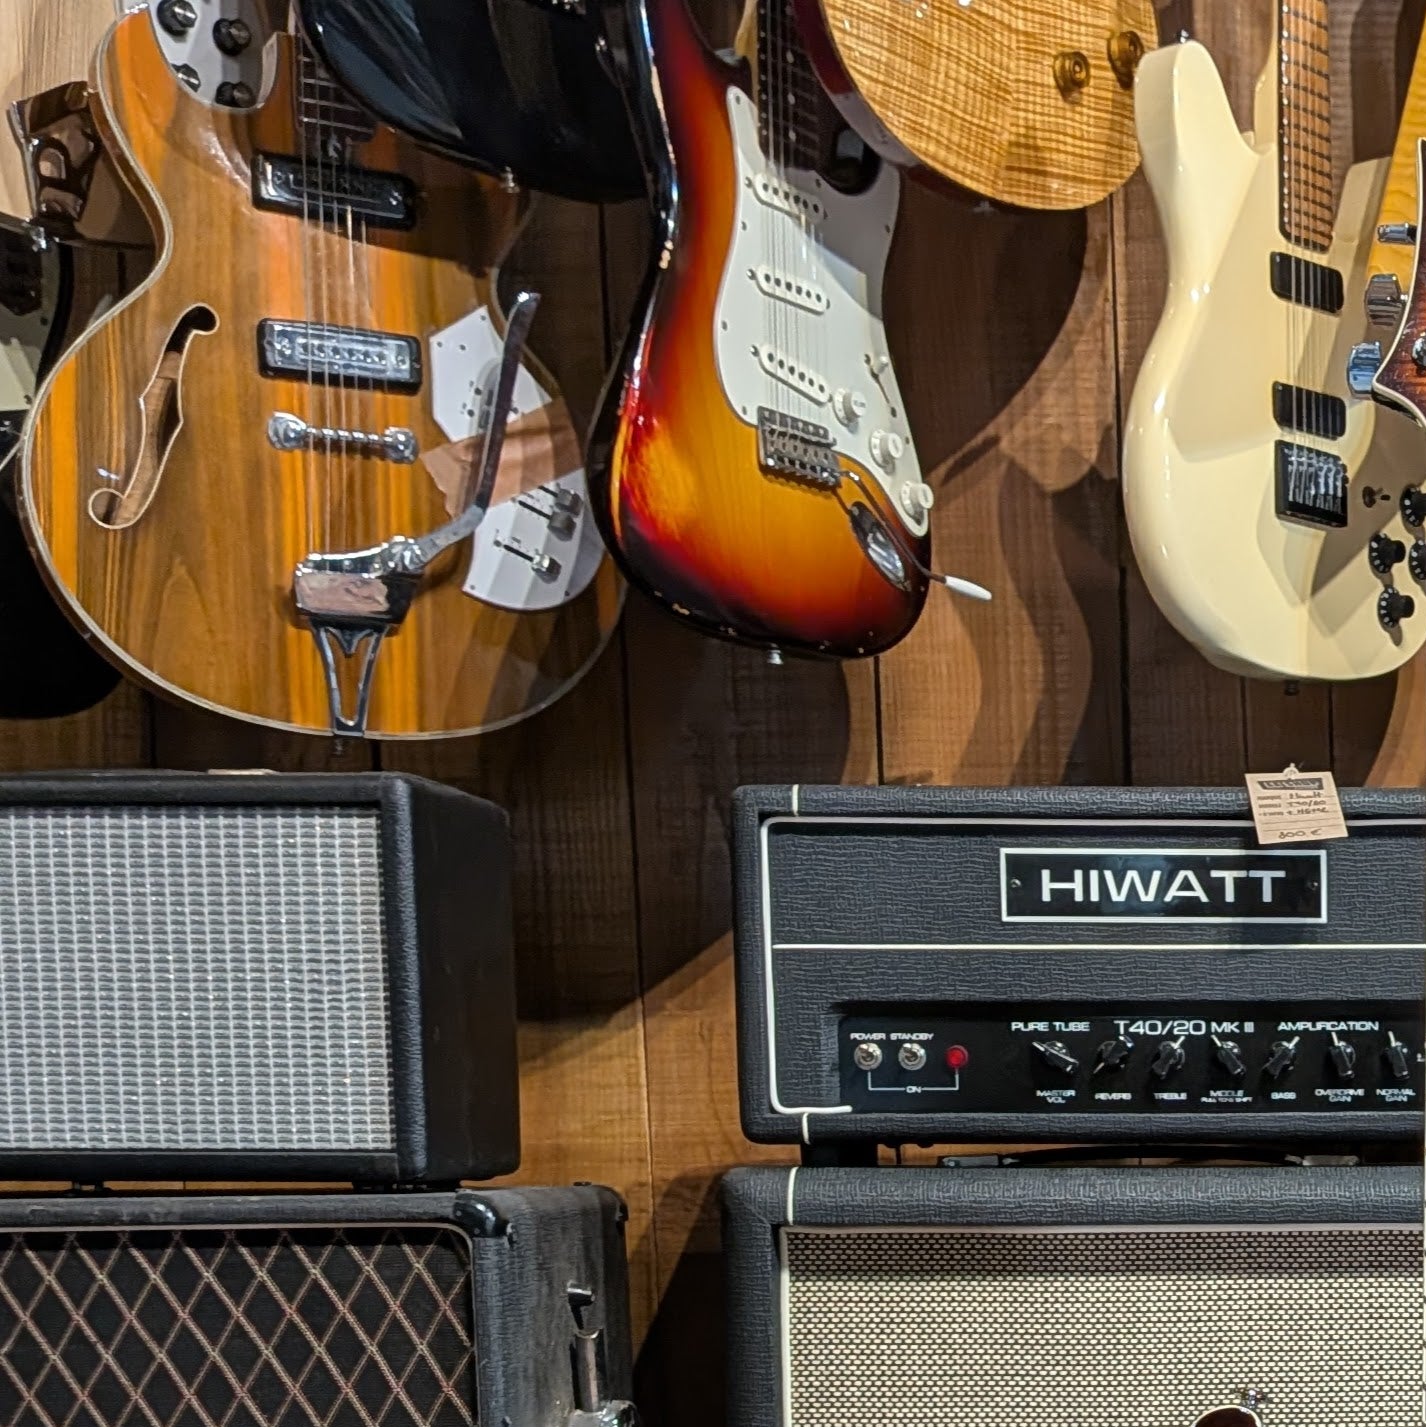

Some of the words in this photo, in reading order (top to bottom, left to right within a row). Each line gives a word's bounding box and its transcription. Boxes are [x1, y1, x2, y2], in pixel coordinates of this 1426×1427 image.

[1041, 869, 1286, 903] HIWATT
[1011, 1021, 1049, 1032] PURE
[1052, 1021, 1090, 1032] TUBE
[1113, 1020, 1206, 1036] T40/20
[1210, 1021, 1240, 1033] MK
[1277, 1021, 1379, 1032] AMPLIFICATION
[850, 1033, 886, 1041] POWER
[890, 1033, 934, 1041] STANDBY
[906, 1085, 921, 1094] ON
[1314, 1088, 1365, 1097] OVERDRIVE
[1376, 1088, 1416, 1096] NORMAL
[1046, 1096, 1065, 1104] VOL
[1094, 1092, 1132, 1100] REVERB
[1153, 1092, 1187, 1100] TREBLE
[1270, 1092, 1296, 1100] BASS
